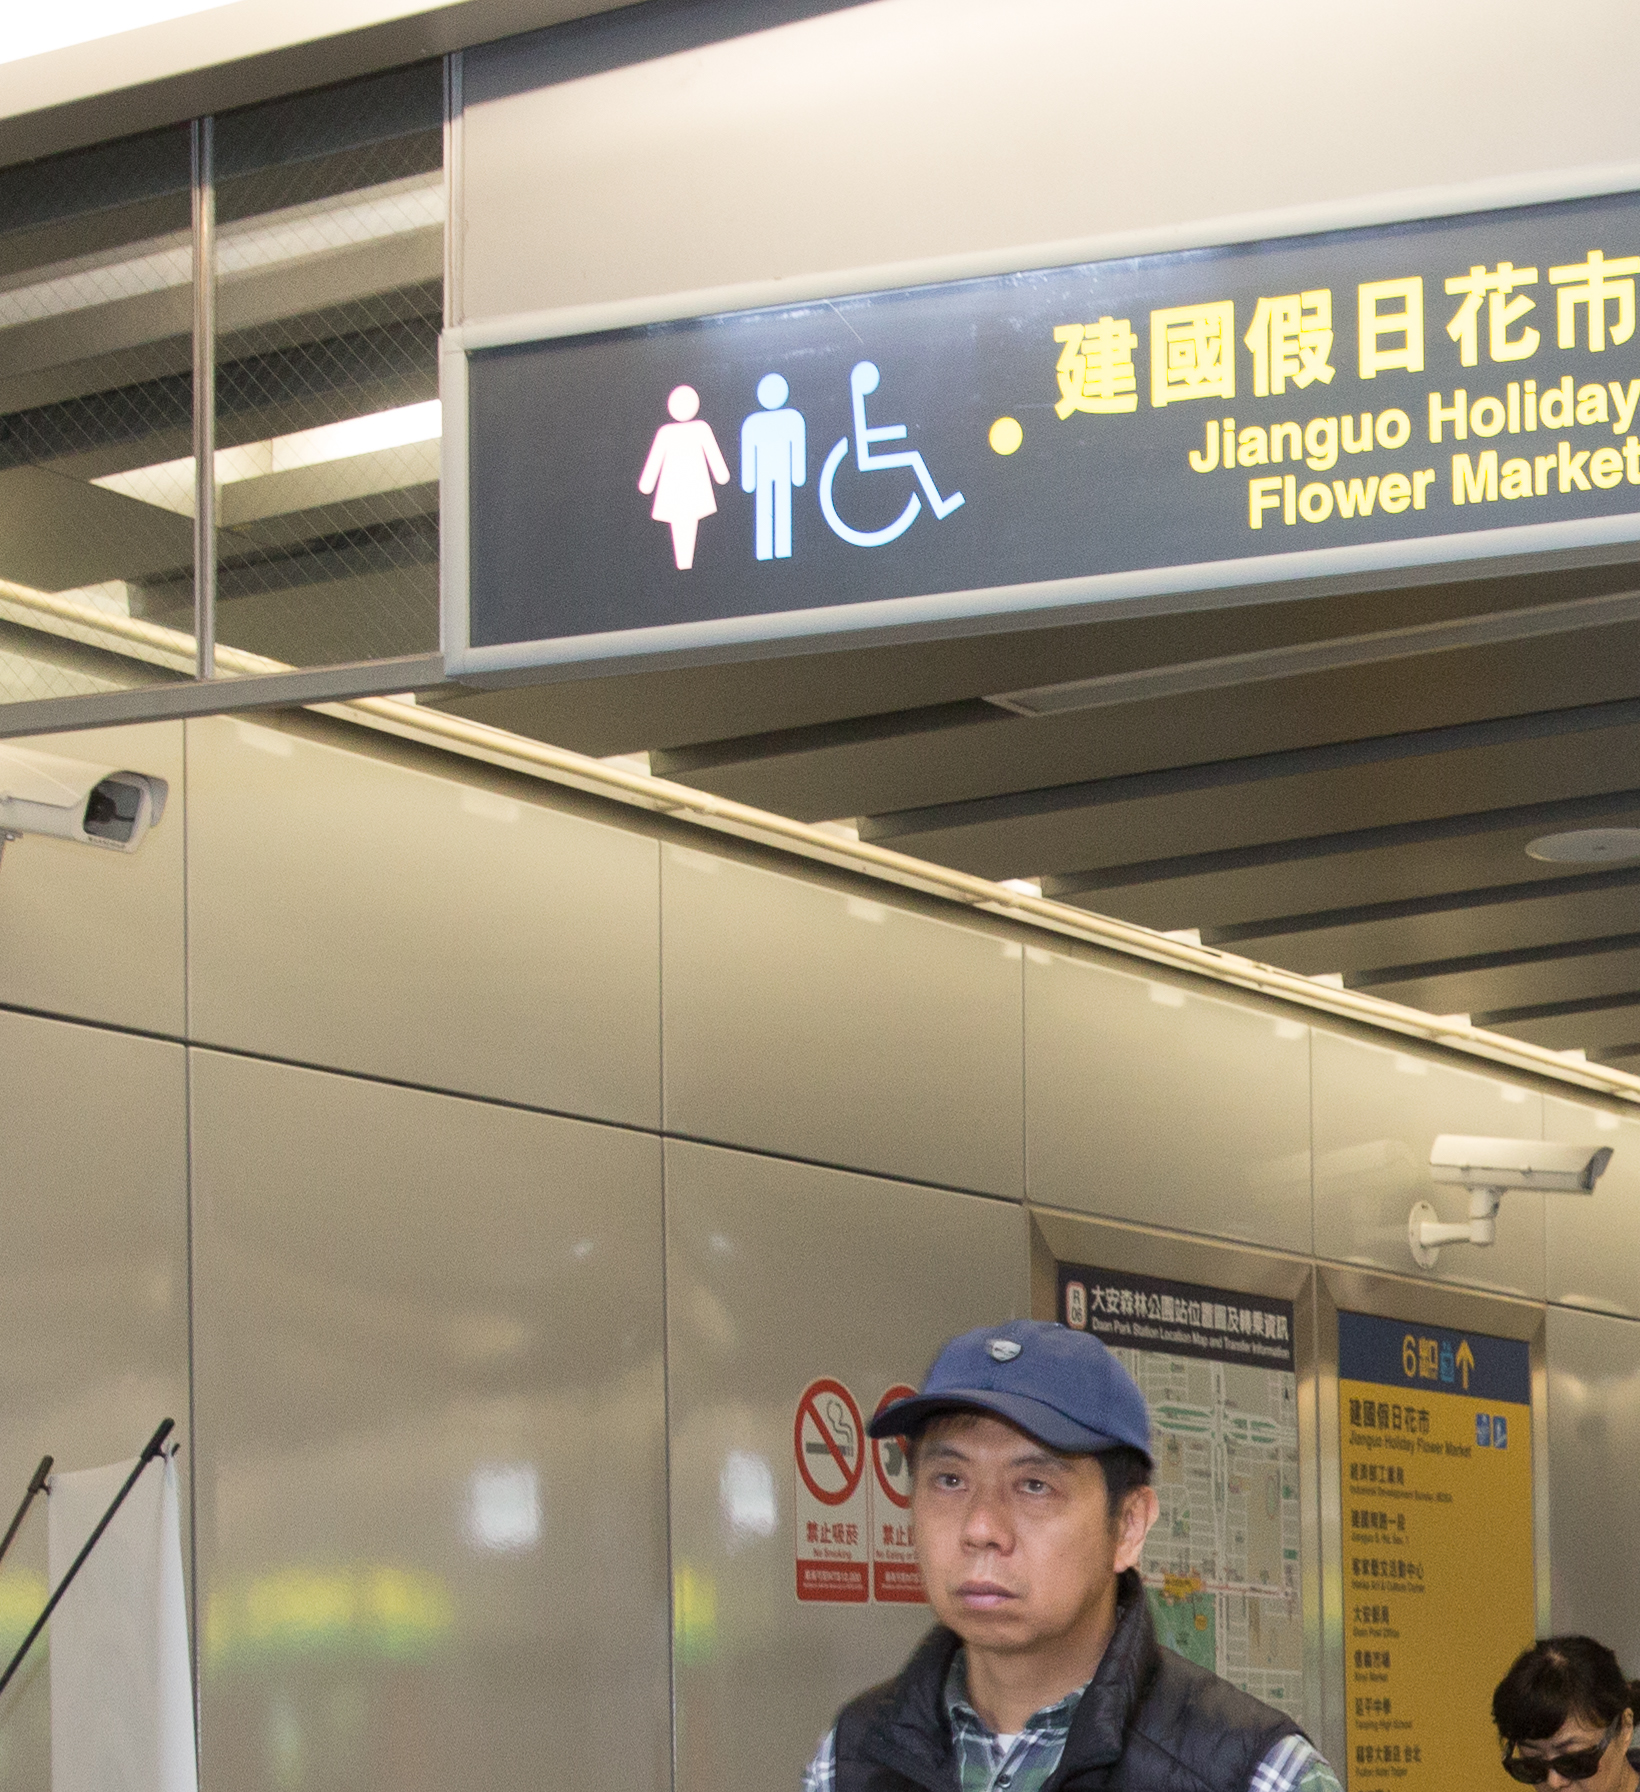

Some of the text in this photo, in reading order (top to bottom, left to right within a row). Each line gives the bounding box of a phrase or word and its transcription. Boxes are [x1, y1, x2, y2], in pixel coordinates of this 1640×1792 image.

[1053, 250, 1640, 421] 建國假日花市
[1189, 412, 1410, 475] Jianguo
[1247, 472, 1433, 529] Flower
[1402, 1334, 1417, 1378] 6
